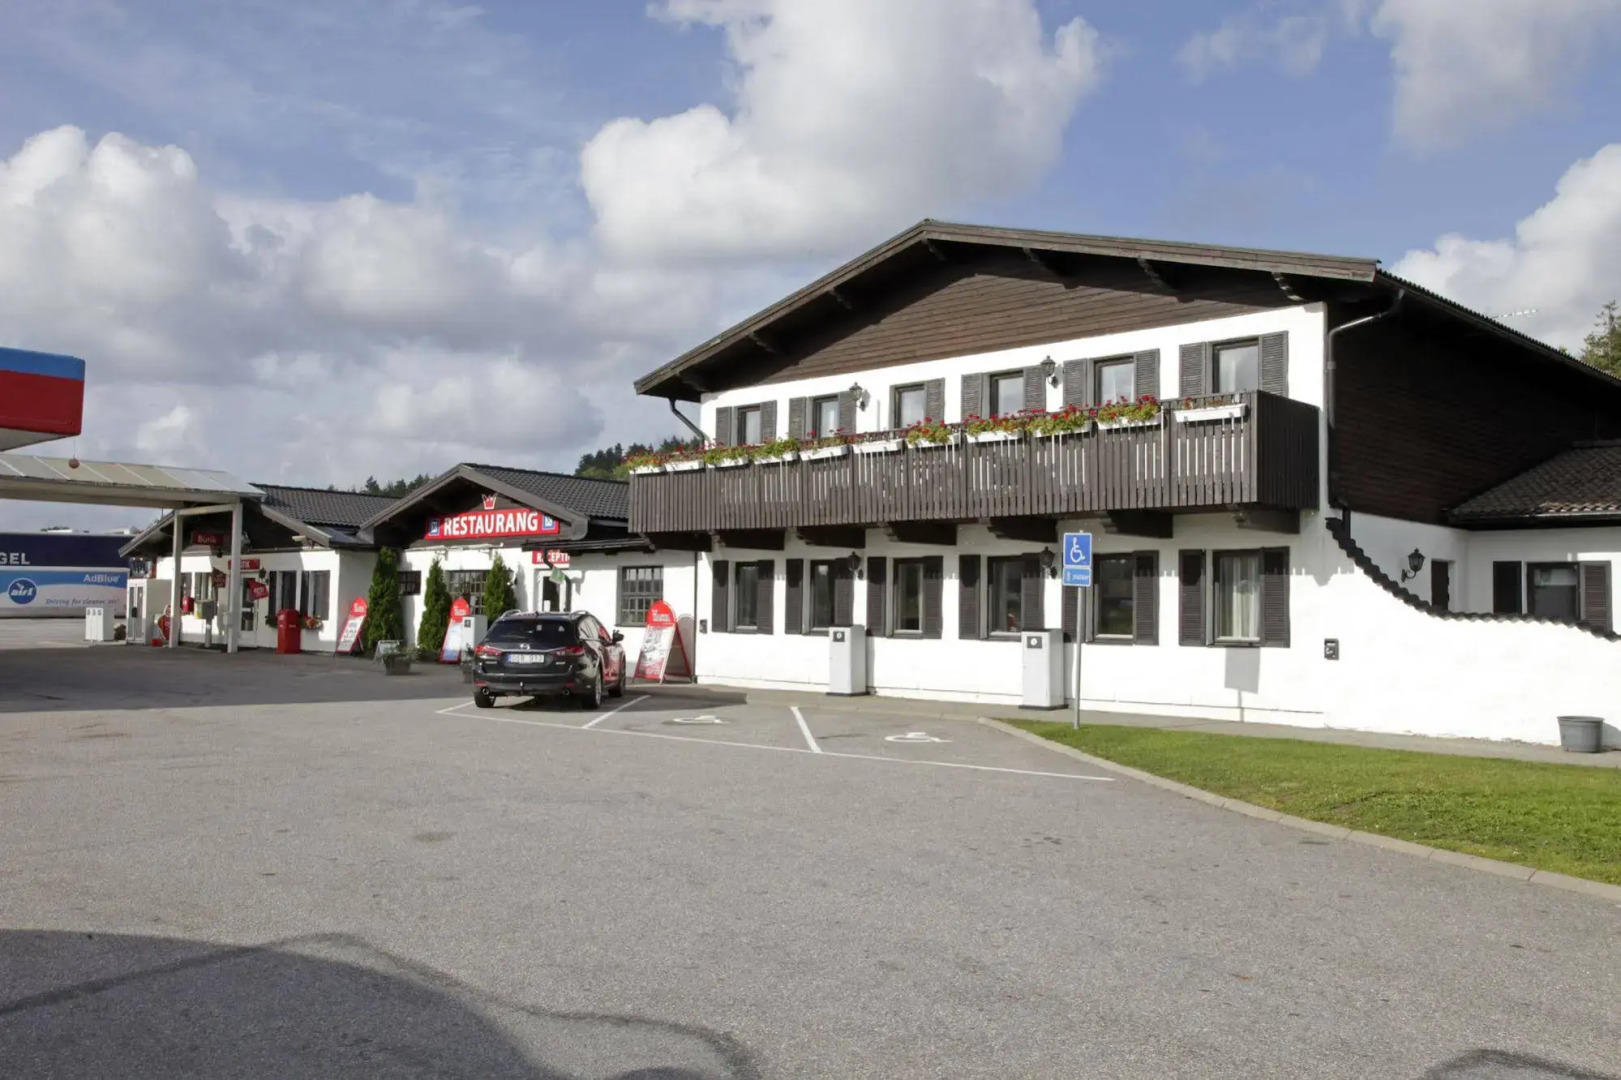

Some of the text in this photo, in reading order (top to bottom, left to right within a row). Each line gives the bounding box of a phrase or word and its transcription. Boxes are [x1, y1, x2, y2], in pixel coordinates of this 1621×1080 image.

[444, 512, 538, 536] RESTAURANG
[83, 574, 119, 583] AdBlue
[71, 598, 81, 606] for
